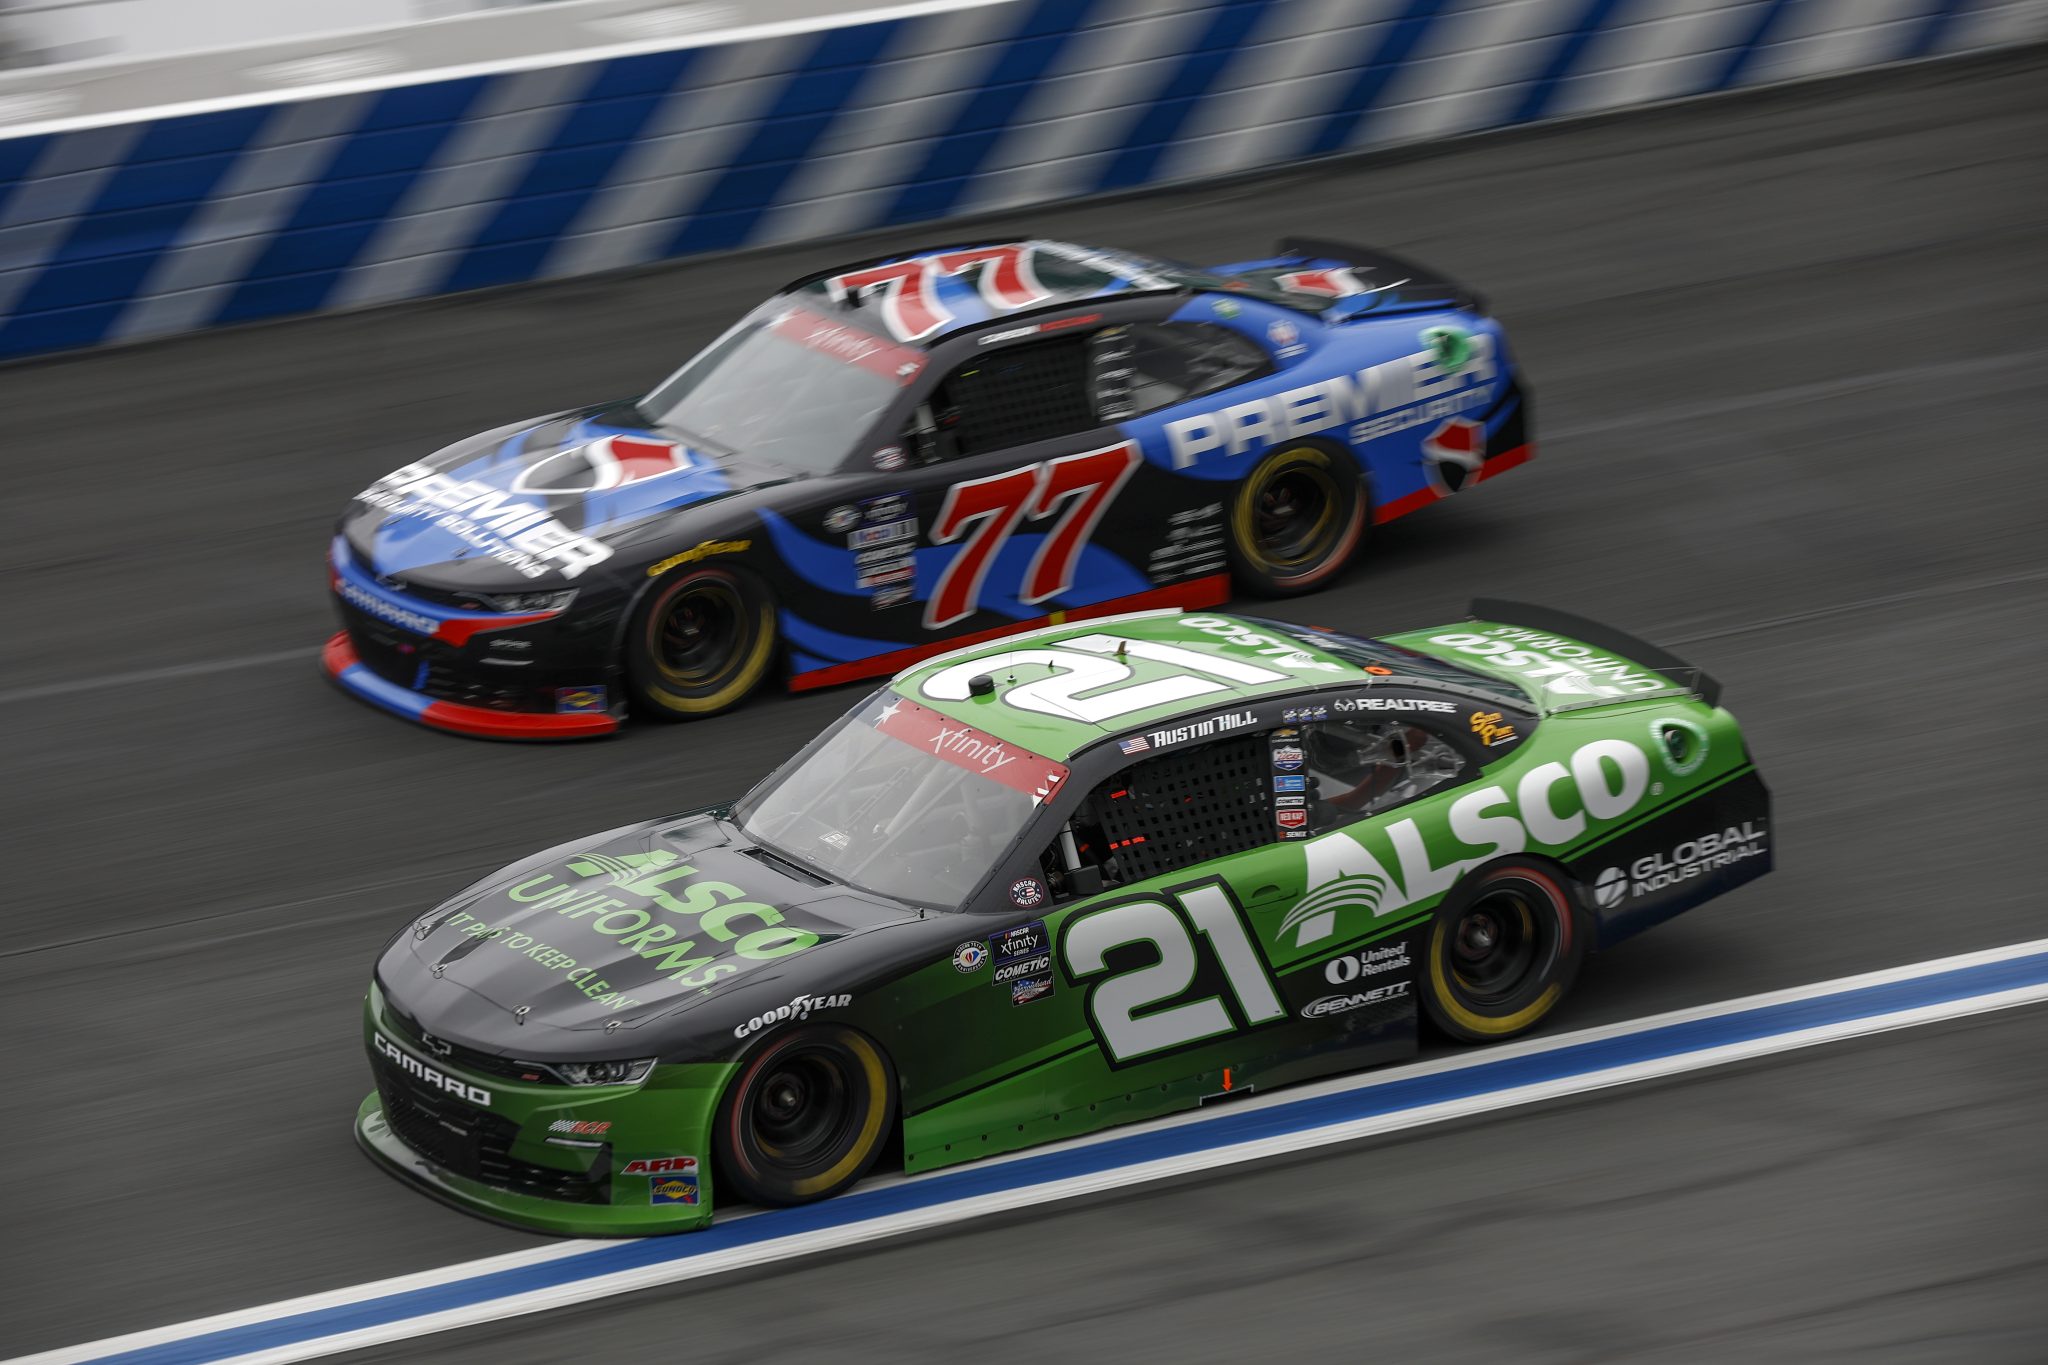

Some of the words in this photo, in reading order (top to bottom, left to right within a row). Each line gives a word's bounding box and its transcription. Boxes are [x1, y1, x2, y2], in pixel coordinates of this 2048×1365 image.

[922, 438, 1143, 630] 77
[1177, 616, 1344, 673] ALSCO
[1427, 633, 1630, 698] ALSCO
[1481, 626, 1665, 693] UNIFORMS
[918, 632, 1294, 724] 21
[1357, 698, 1457, 713] REALTREE
[928, 727, 1016, 774] xfinity
[1147, 720, 1214, 748] AUSTIN
[1212, 711, 1258, 732] HILL
[1276, 739, 1649, 948] ALSCO
[1631, 821, 1767, 879] GLOBAL
[1632, 842, 1768, 897] INDUSTRIAL
[508, 873, 738, 988] UNIFORMS
[566, 849, 820, 960] ALSCO
[1010, 926, 1030, 938] NASCAR
[444, 912, 475, 926] IT
[500, 931, 534, 949] TO
[522, 943, 577, 970] KEEP
[566, 967, 627, 1010] CLEAN
[995, 956, 1050, 981] COMETIC
[1000, 935, 1039, 955] xfinity
[1361, 941, 1409, 964] United
[1361, 954, 1411, 977] Rentals
[1066, 884, 1284, 1063] 21
[1312, 980, 1412, 1015] BENNETT
[734, 994, 853, 1039] GOODYEAR
[374, 1031, 492, 1106] CAMARO
[623, 1157, 697, 1173] ARP
[653, 1182, 697, 1195] SUNOCO
